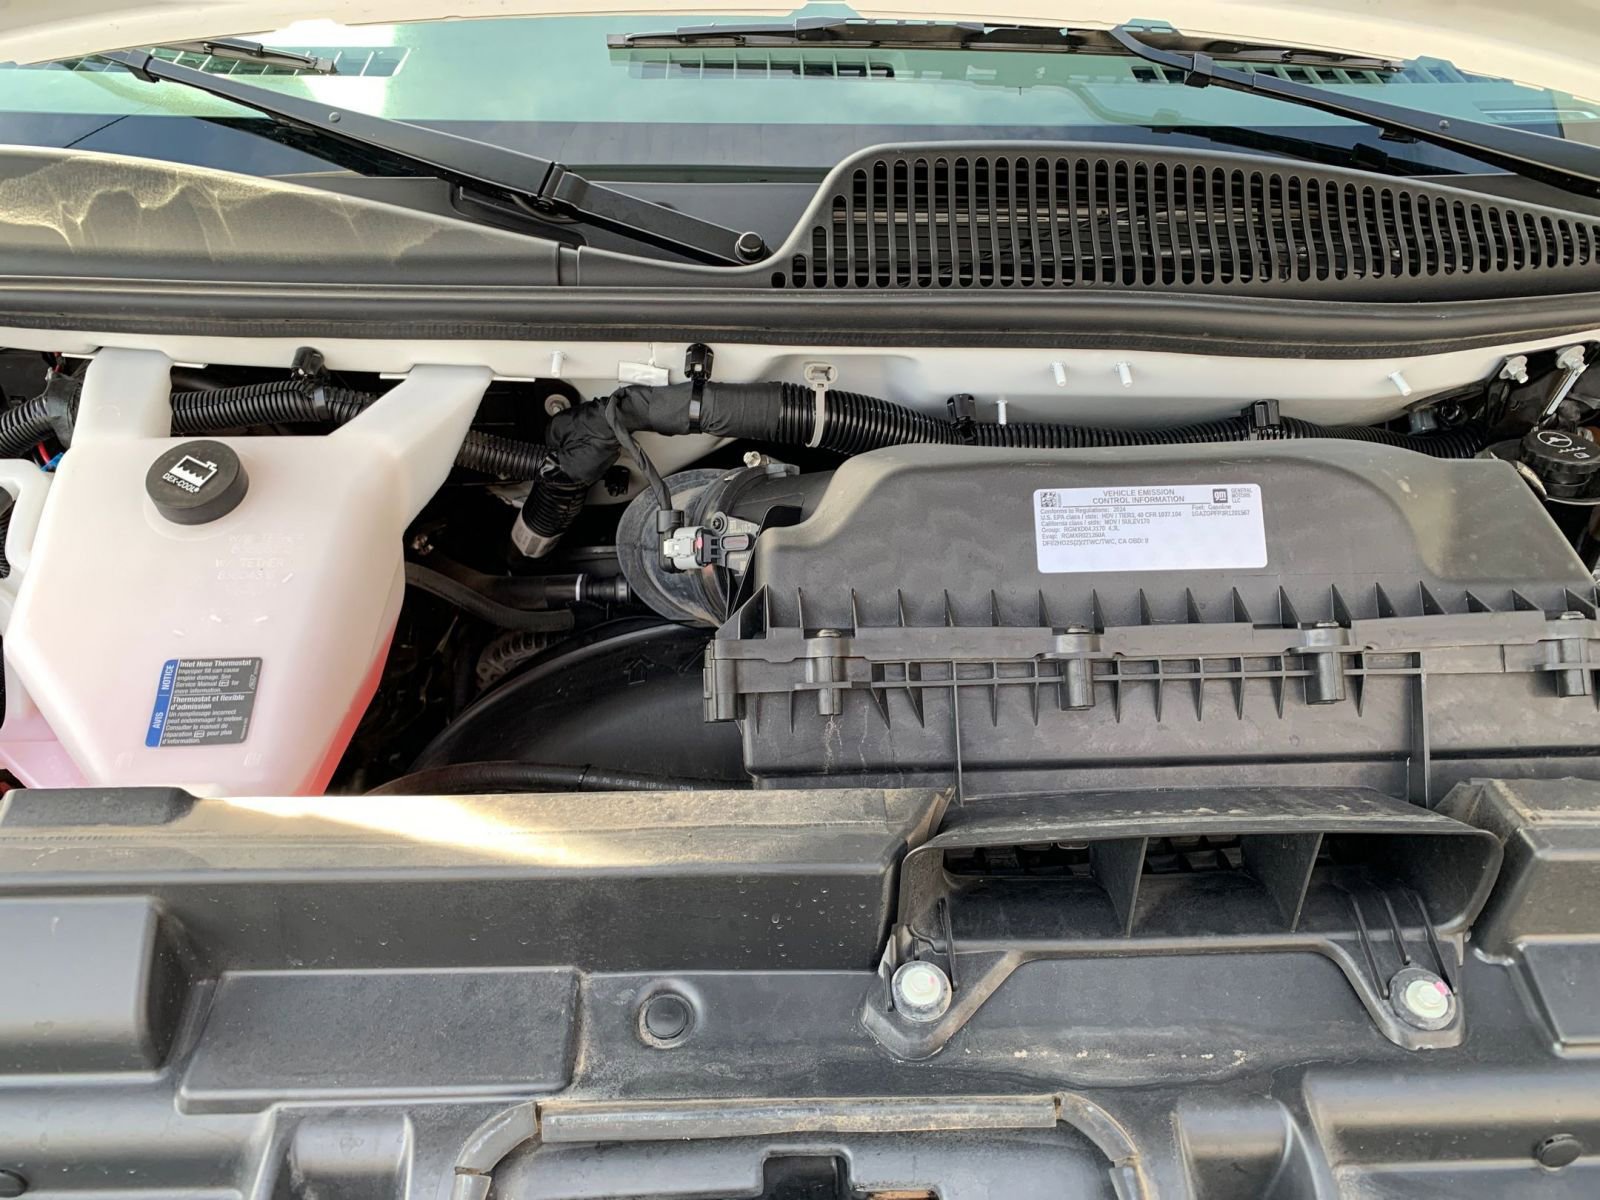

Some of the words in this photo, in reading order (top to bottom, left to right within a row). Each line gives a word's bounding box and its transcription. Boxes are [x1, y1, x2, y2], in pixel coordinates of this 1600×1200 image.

[1214, 490, 1227, 502] gm
[161, 664, 174, 690] NOTICE
[152, 712, 164, 729] AVIS
